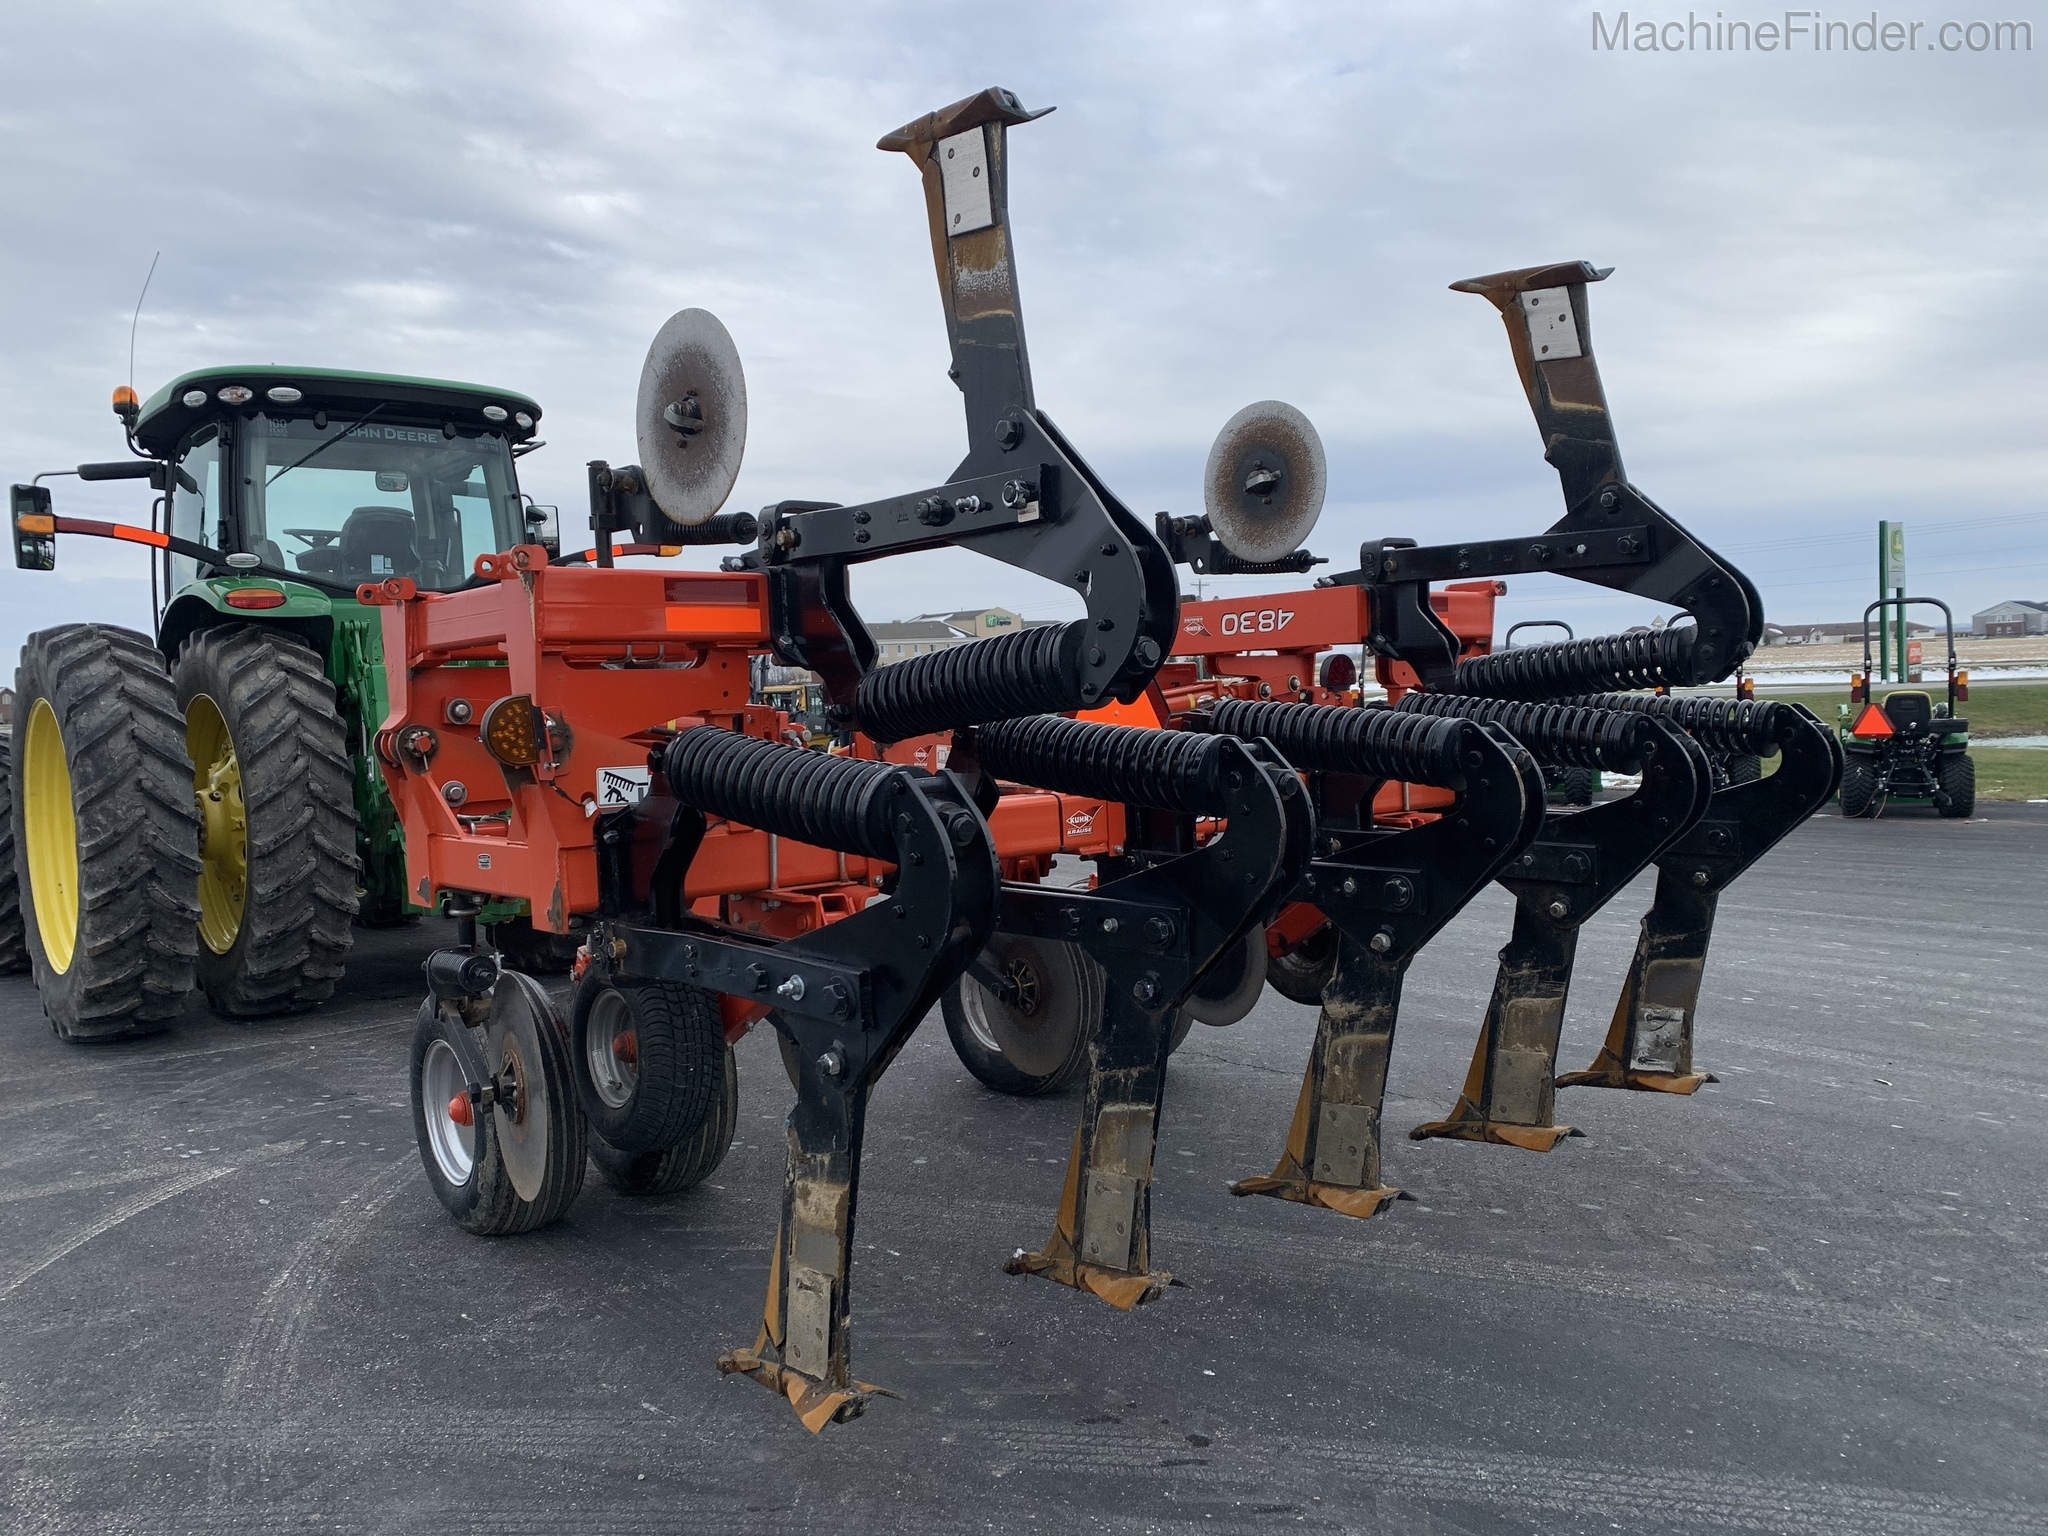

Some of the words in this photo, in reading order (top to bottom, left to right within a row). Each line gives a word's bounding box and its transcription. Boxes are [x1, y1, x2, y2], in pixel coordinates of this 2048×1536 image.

[269, 419, 287, 429] 100
[384, 427, 438, 443] DEERE
[1221, 609, 1295, 636] 4830
[1070, 815, 1089, 824] KUHN
[1067, 826, 1092, 836] KRAUSE
